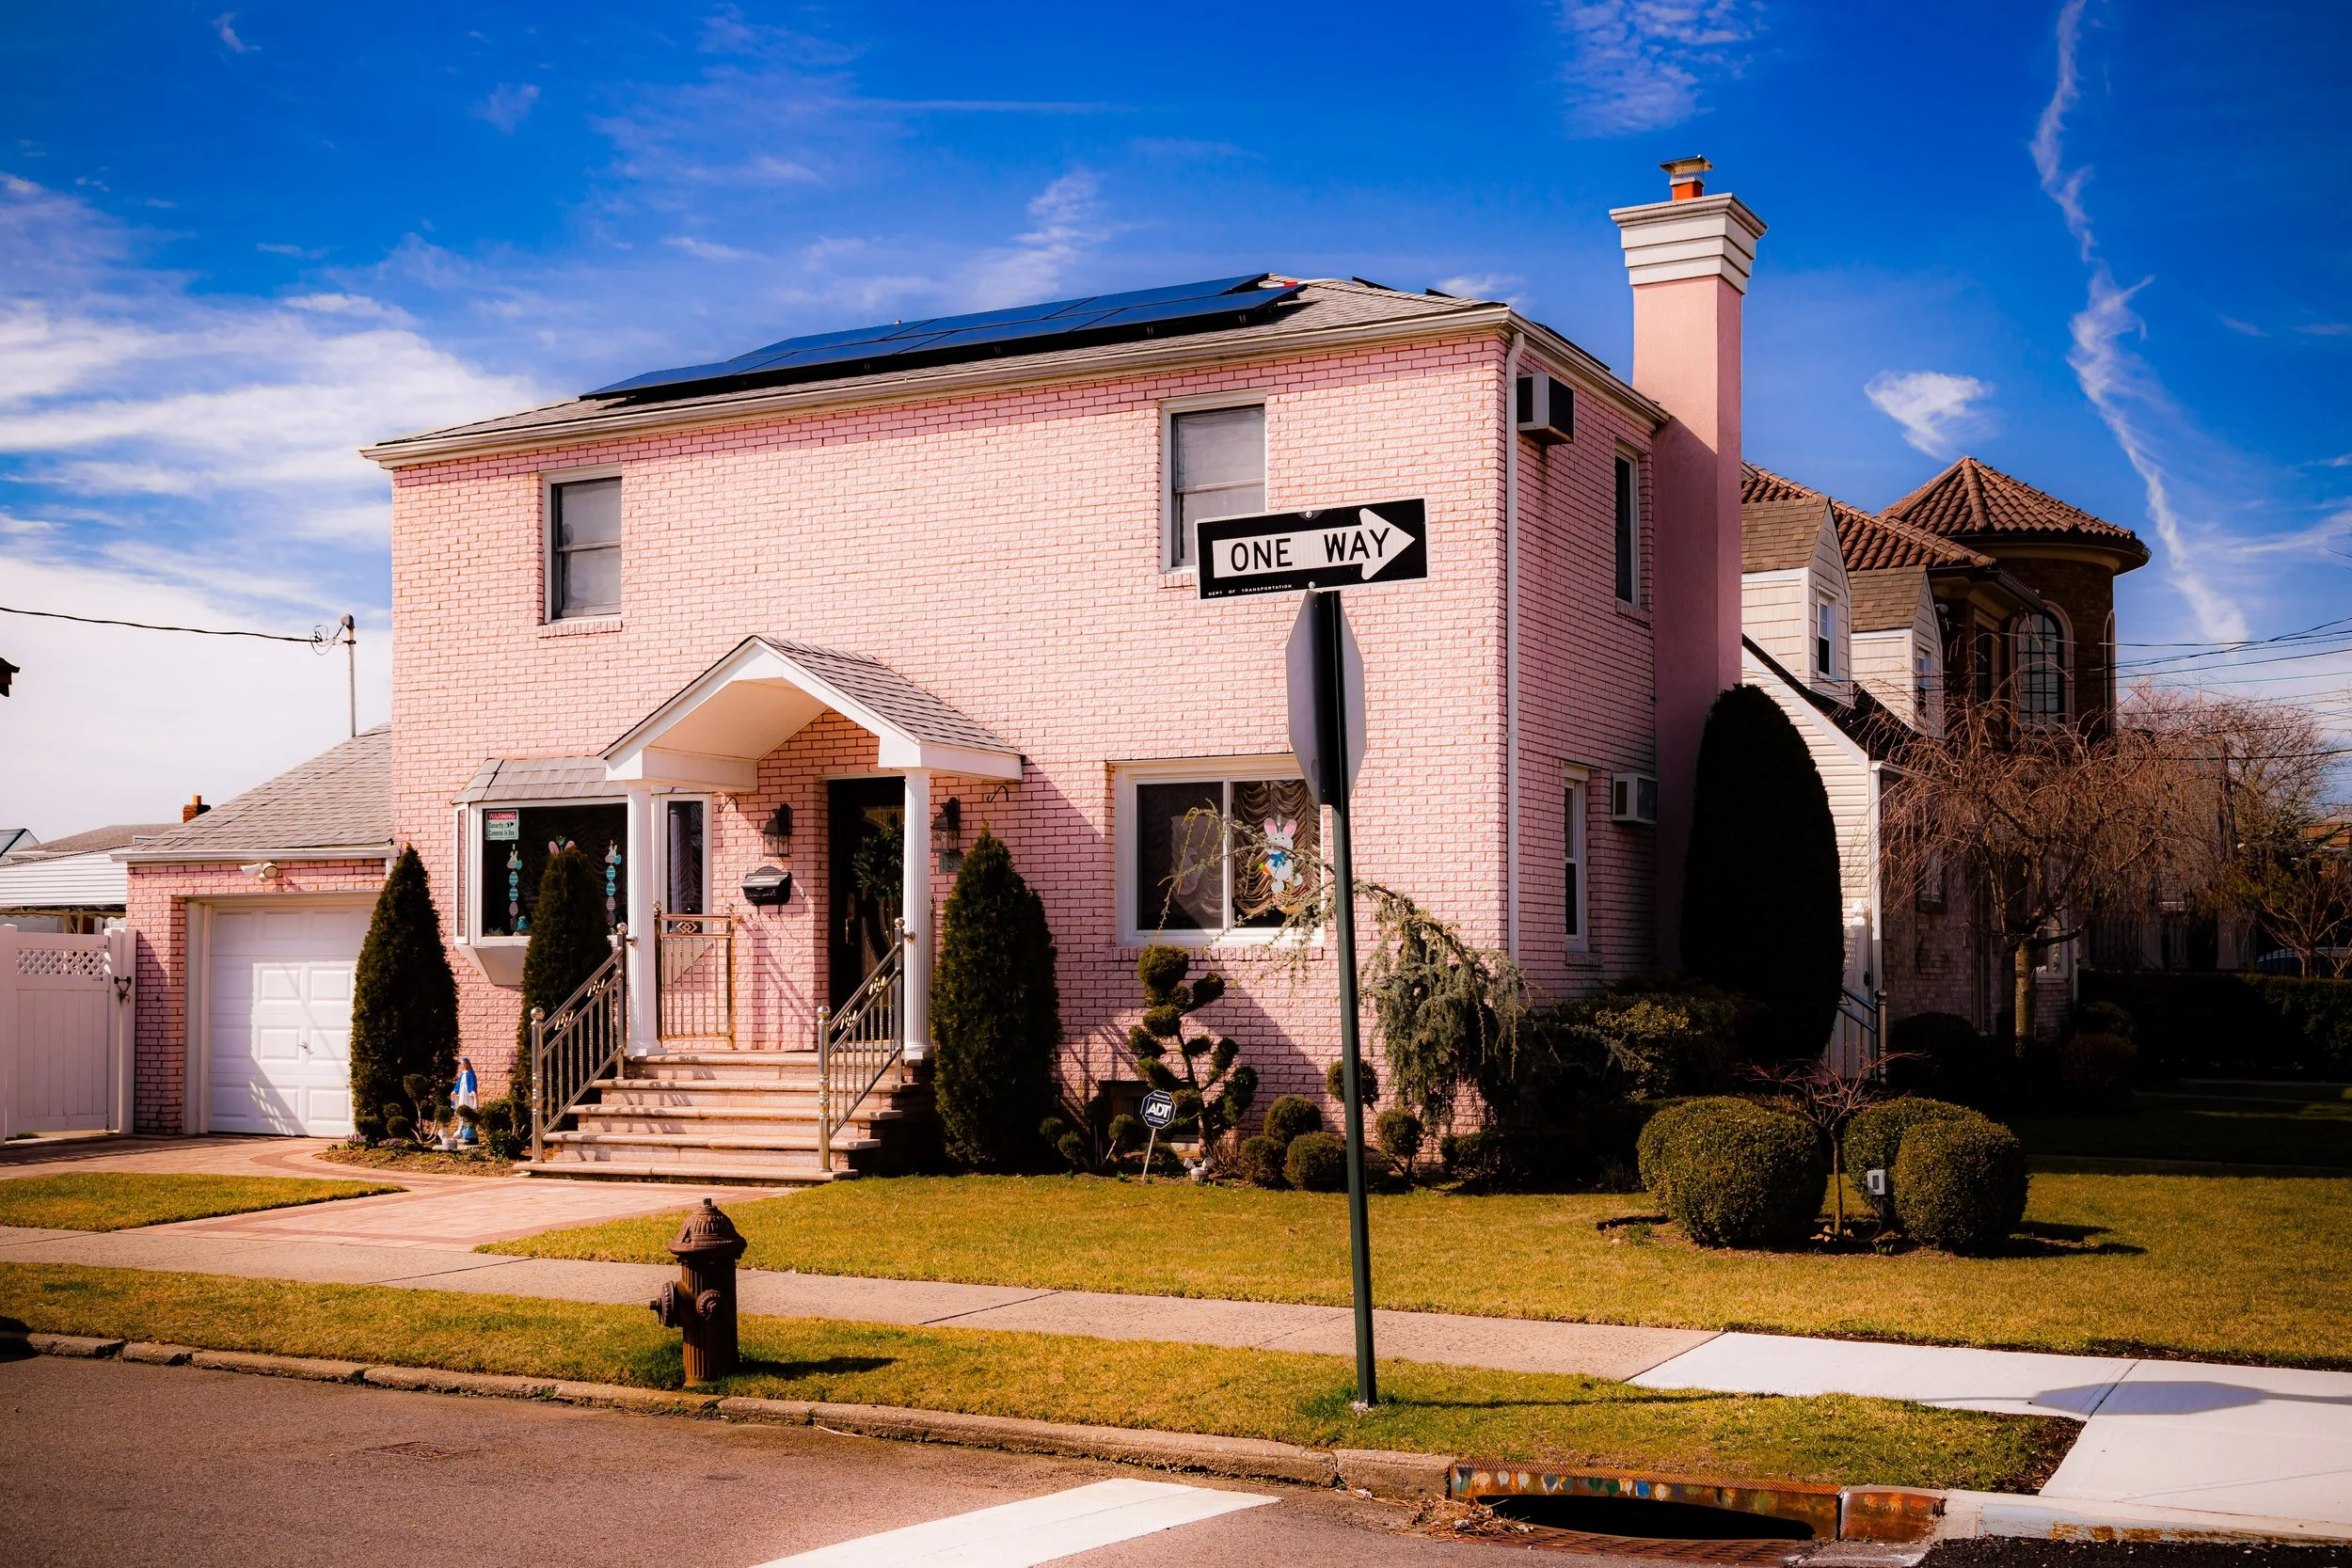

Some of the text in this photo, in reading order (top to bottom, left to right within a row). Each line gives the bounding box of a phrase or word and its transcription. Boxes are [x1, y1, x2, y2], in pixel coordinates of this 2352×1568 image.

[1231, 527, 1391, 572] ONE WAY
[1241, 583, 1293, 594] TRANSPORTATION
[1147, 1102, 1171, 1117] ADT
